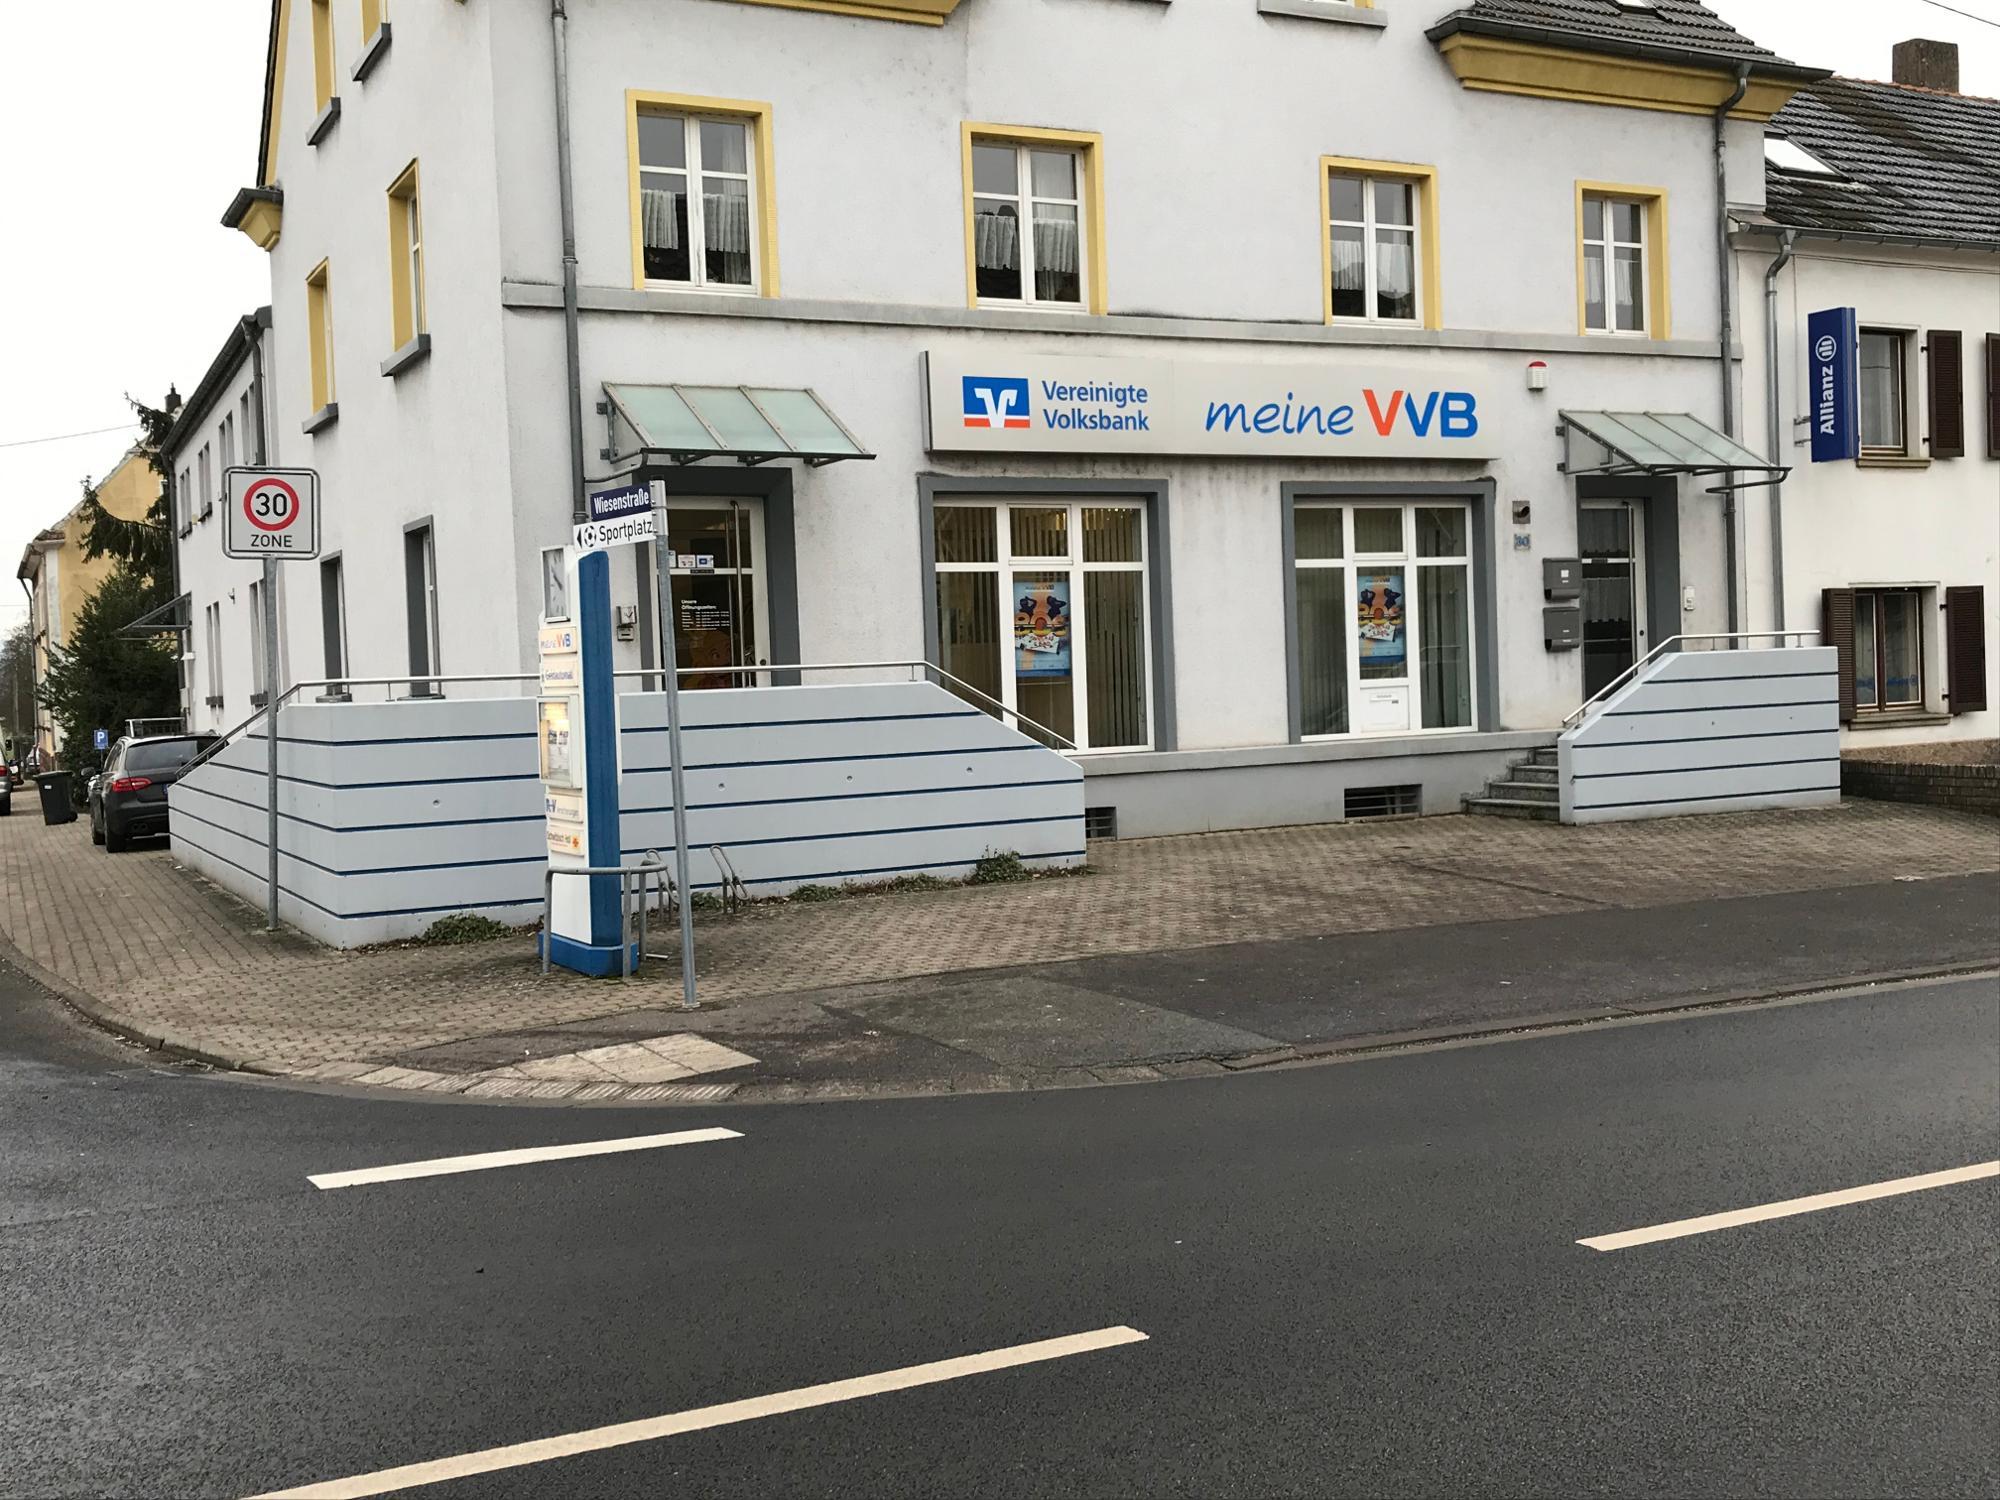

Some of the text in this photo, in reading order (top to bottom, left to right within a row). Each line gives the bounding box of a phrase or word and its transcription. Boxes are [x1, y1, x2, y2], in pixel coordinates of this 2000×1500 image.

[1042, 380, 1148, 408] Vereinigte
[1820, 365, 1835, 435] Allianz
[1043, 408, 1149, 431] Volksbank
[1205, 389, 1478, 438] meine VVB
[255, 492, 288, 517] 30
[594, 488, 649, 514] Wiesenstraße
[250, 534, 293, 548] ZONE
[599, 519, 653, 545] Sportplatz
[97, 731, 105, 743] P
